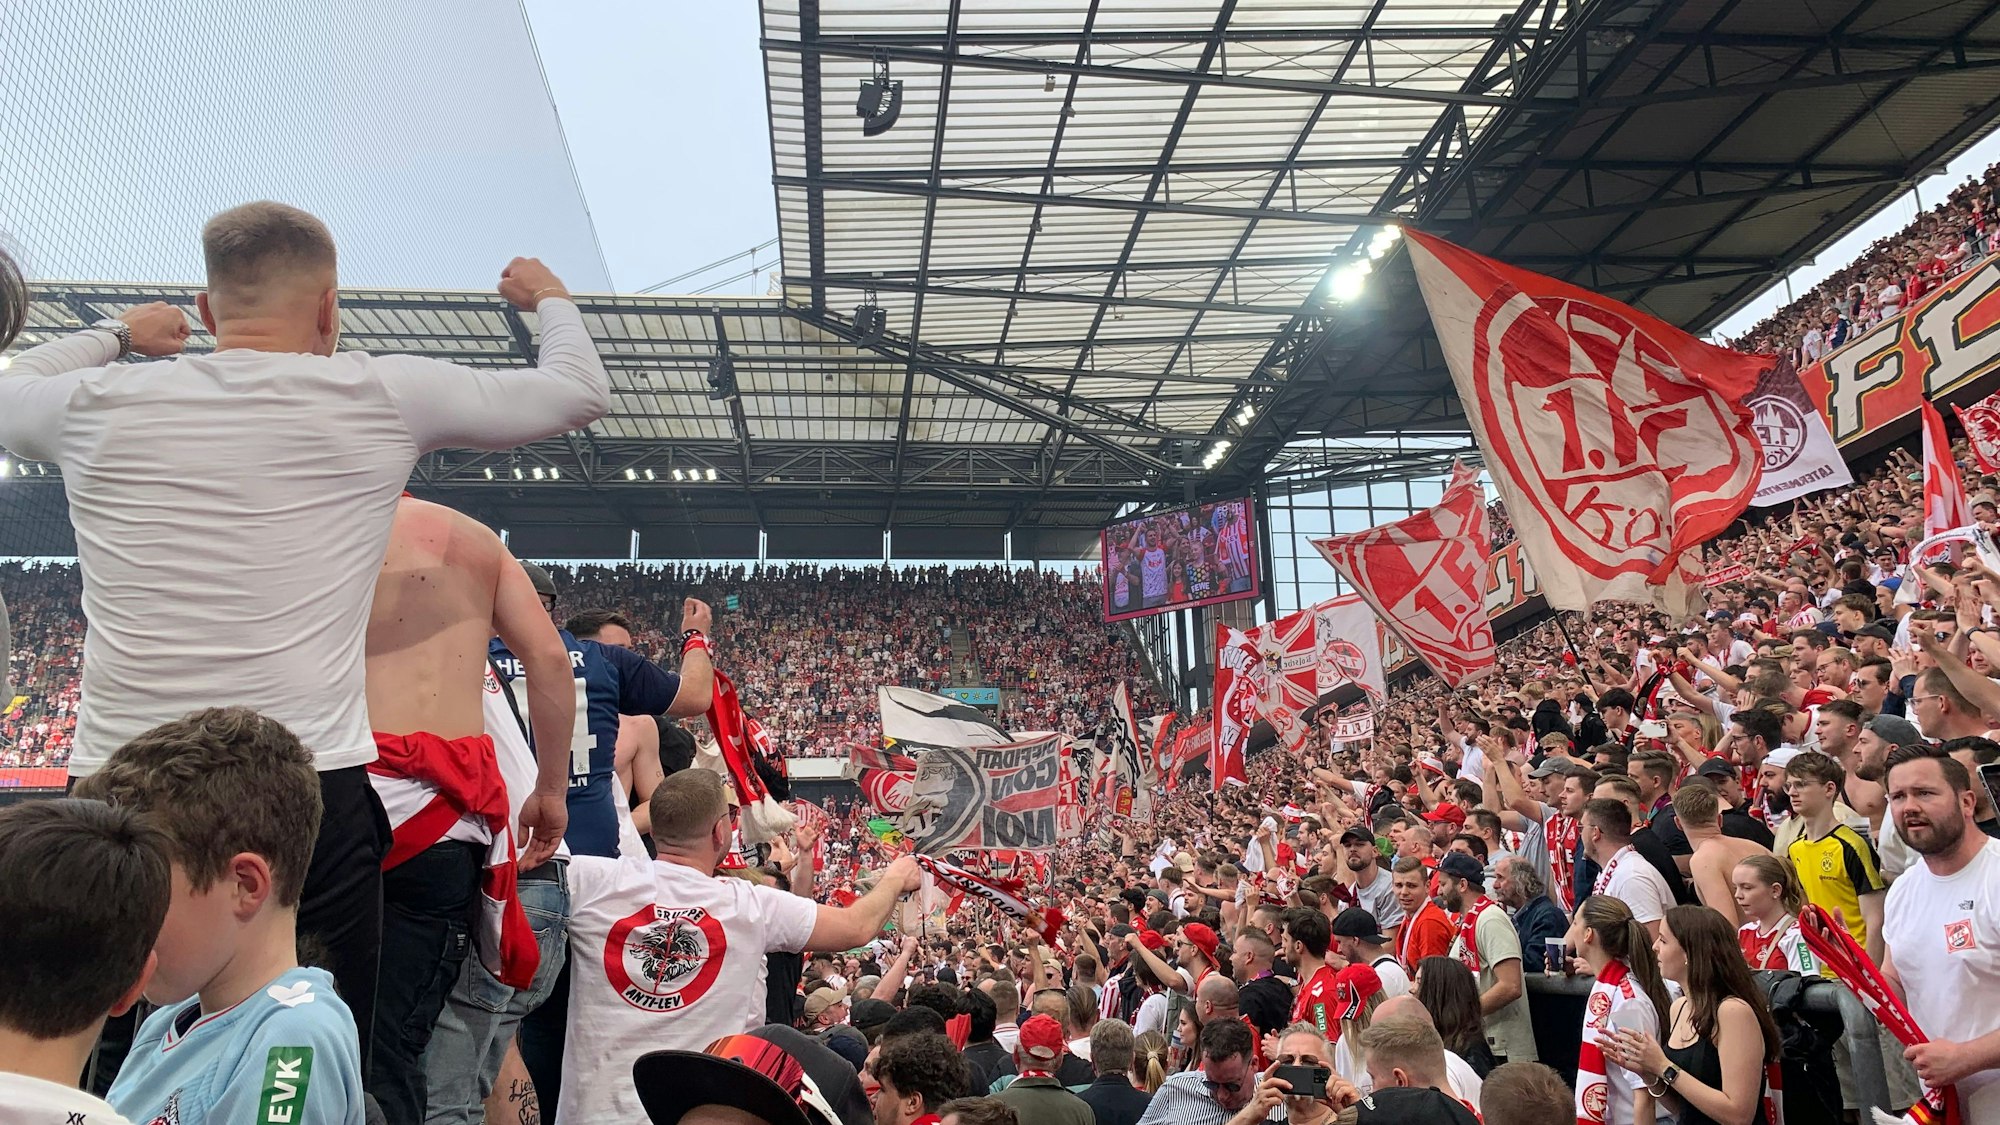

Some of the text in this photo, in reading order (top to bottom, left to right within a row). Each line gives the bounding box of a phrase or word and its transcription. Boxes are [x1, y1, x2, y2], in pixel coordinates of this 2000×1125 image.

[496, 651, 586, 676] HER
[656, 908, 704, 922] GRUPPE
[625, 988, 681, 1010] ANTI-LEV
[1316, 1005, 1326, 1031] DEVK
